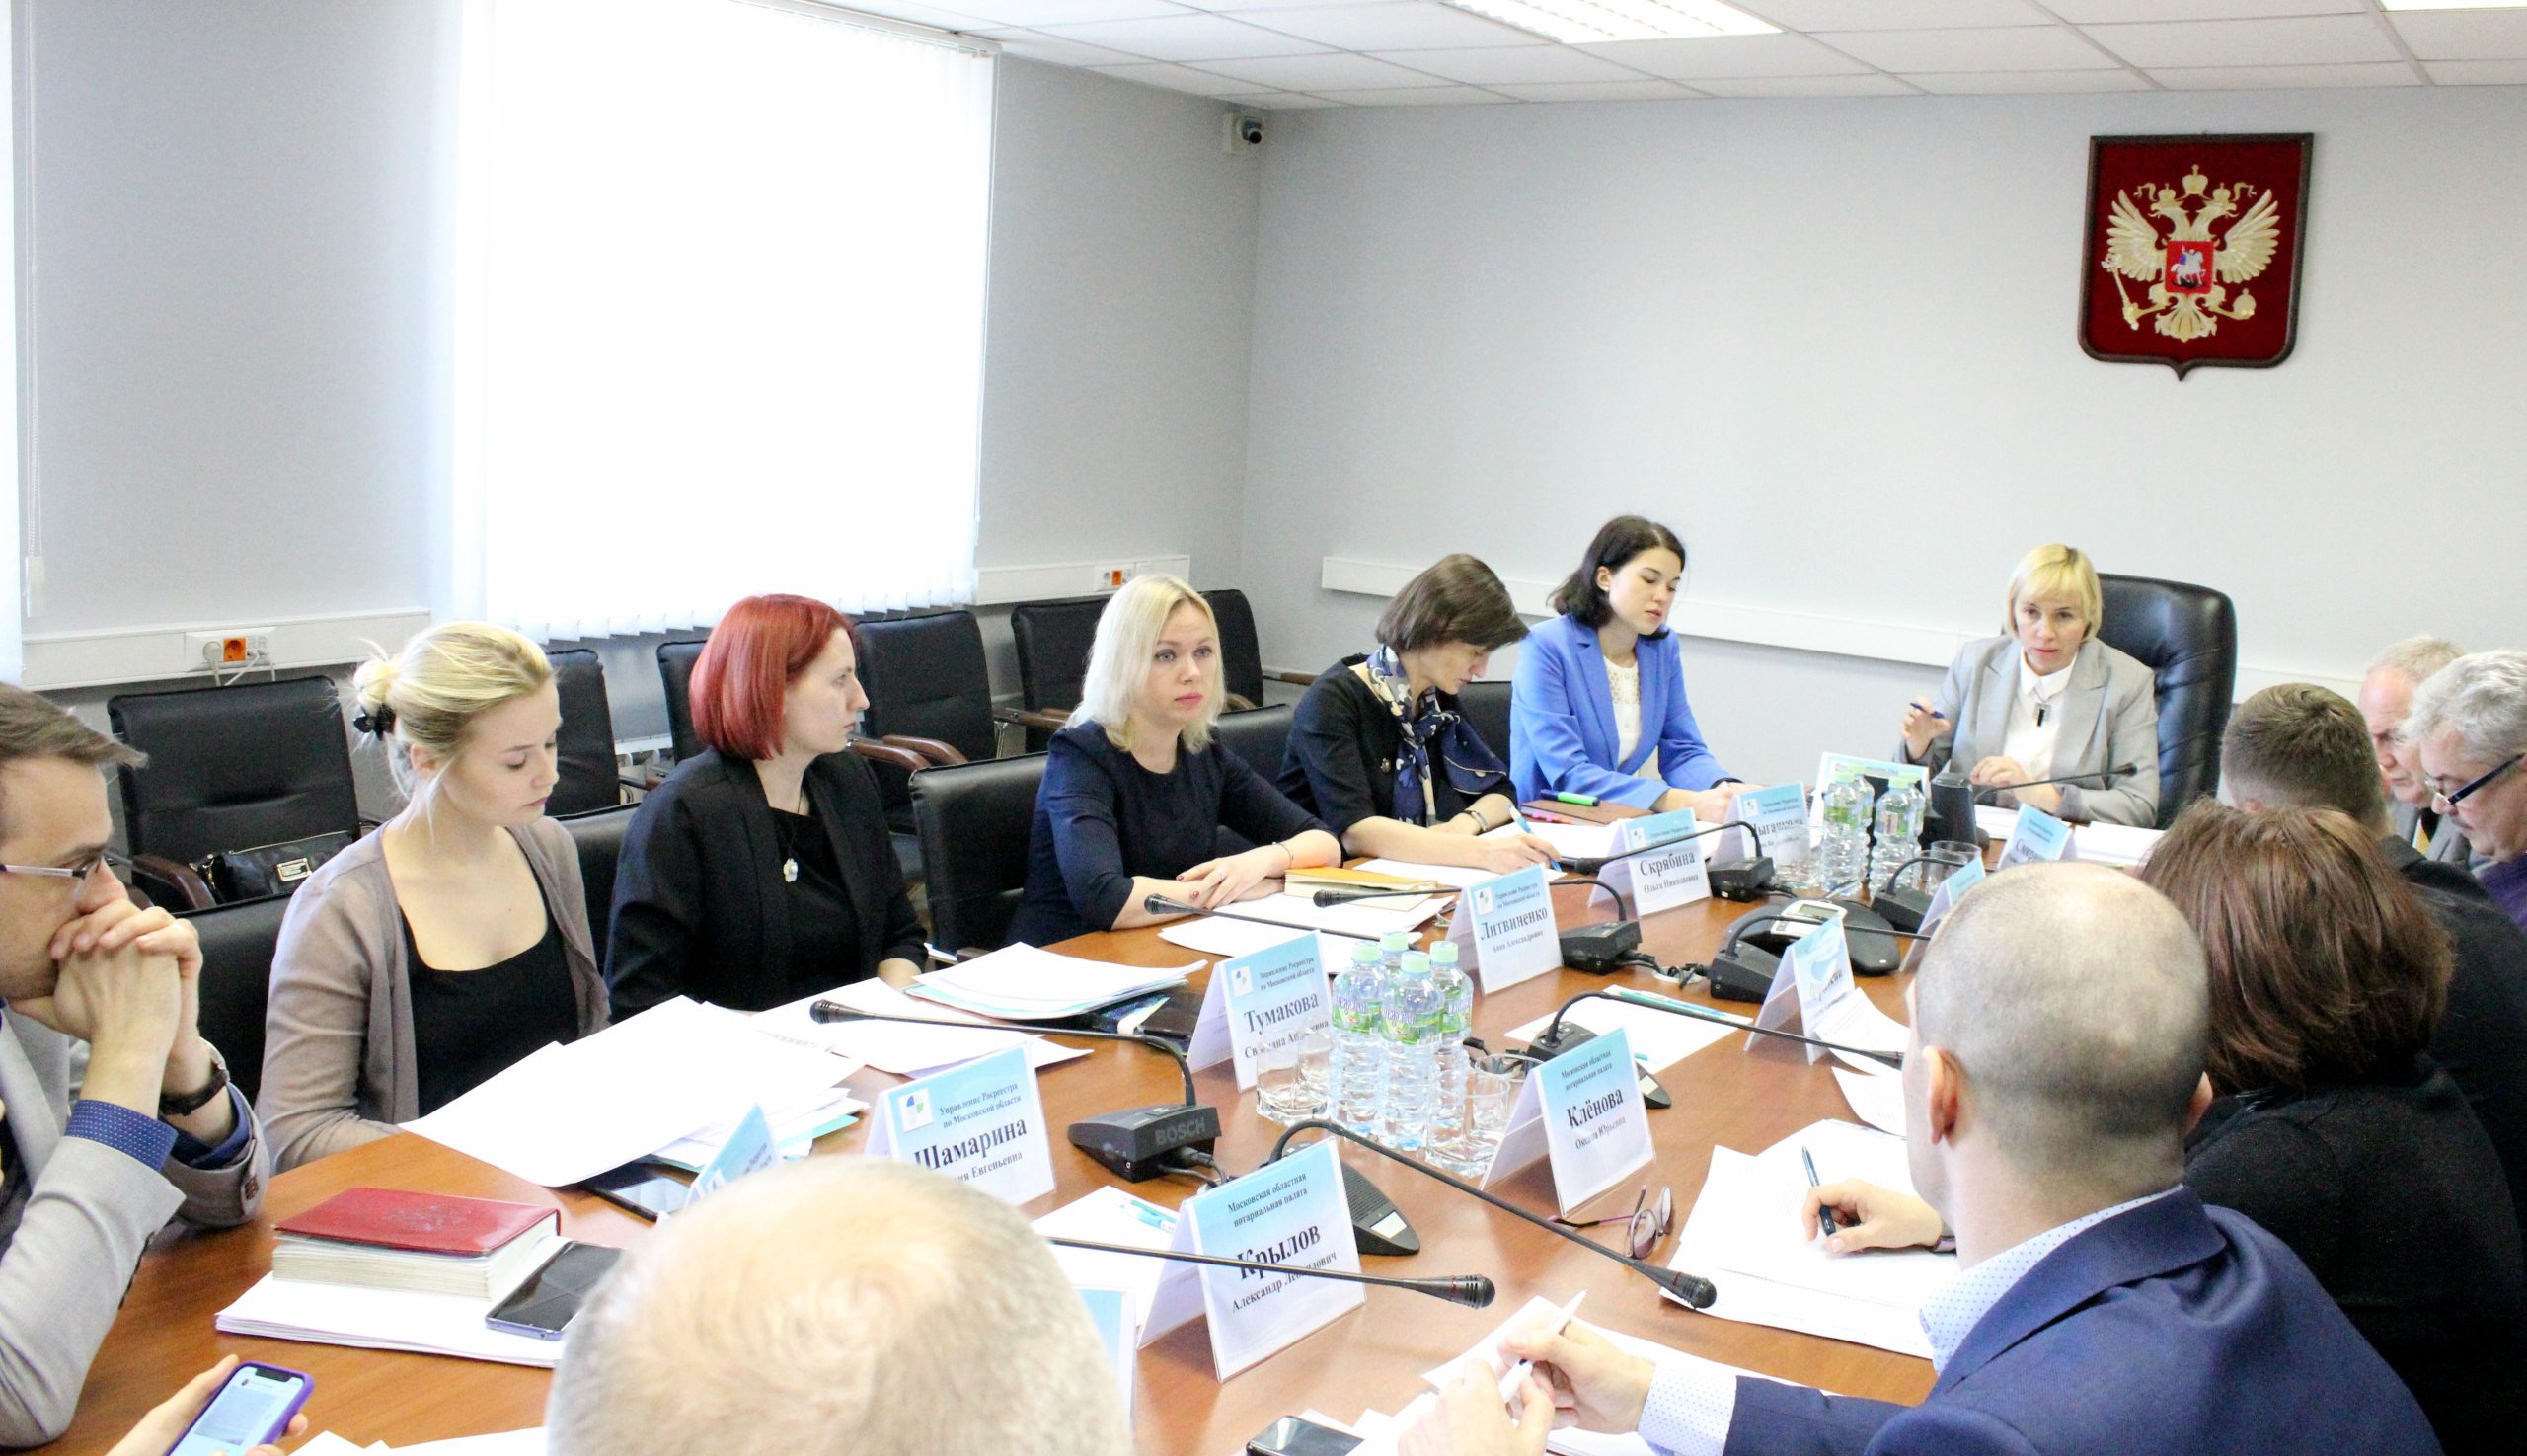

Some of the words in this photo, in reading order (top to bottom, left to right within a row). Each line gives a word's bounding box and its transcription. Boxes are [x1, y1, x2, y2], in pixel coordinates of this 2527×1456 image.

[1640, 852, 1695, 877] Скрябина
[1481, 907, 1548, 941] Литвиненко
[1244, 993, 1320, 1035] Тумакова
[940, 1096, 981, 1115] Управление
[982, 1083, 1018, 1101] Росреестра
[953, 1105, 995, 1125] Московской
[996, 1095, 1022, 1110] области
[1567, 1089, 1624, 1129] Клёнова
[914, 1119, 1028, 1171] Шамарина
[1155, 1116, 1206, 1146] BOSCH
[971, 1151, 1023, 1178] Евгеньевна
[1228, 1188, 1271, 1214] Московская
[1272, 1173, 1307, 1196] областная
[1234, 1199, 1283, 1227] нотариальная
[1284, 1188, 1308, 1204] палата
[1237, 1225, 1321, 1280] Крылов
[1232, 1279, 1282, 1313] Александр
